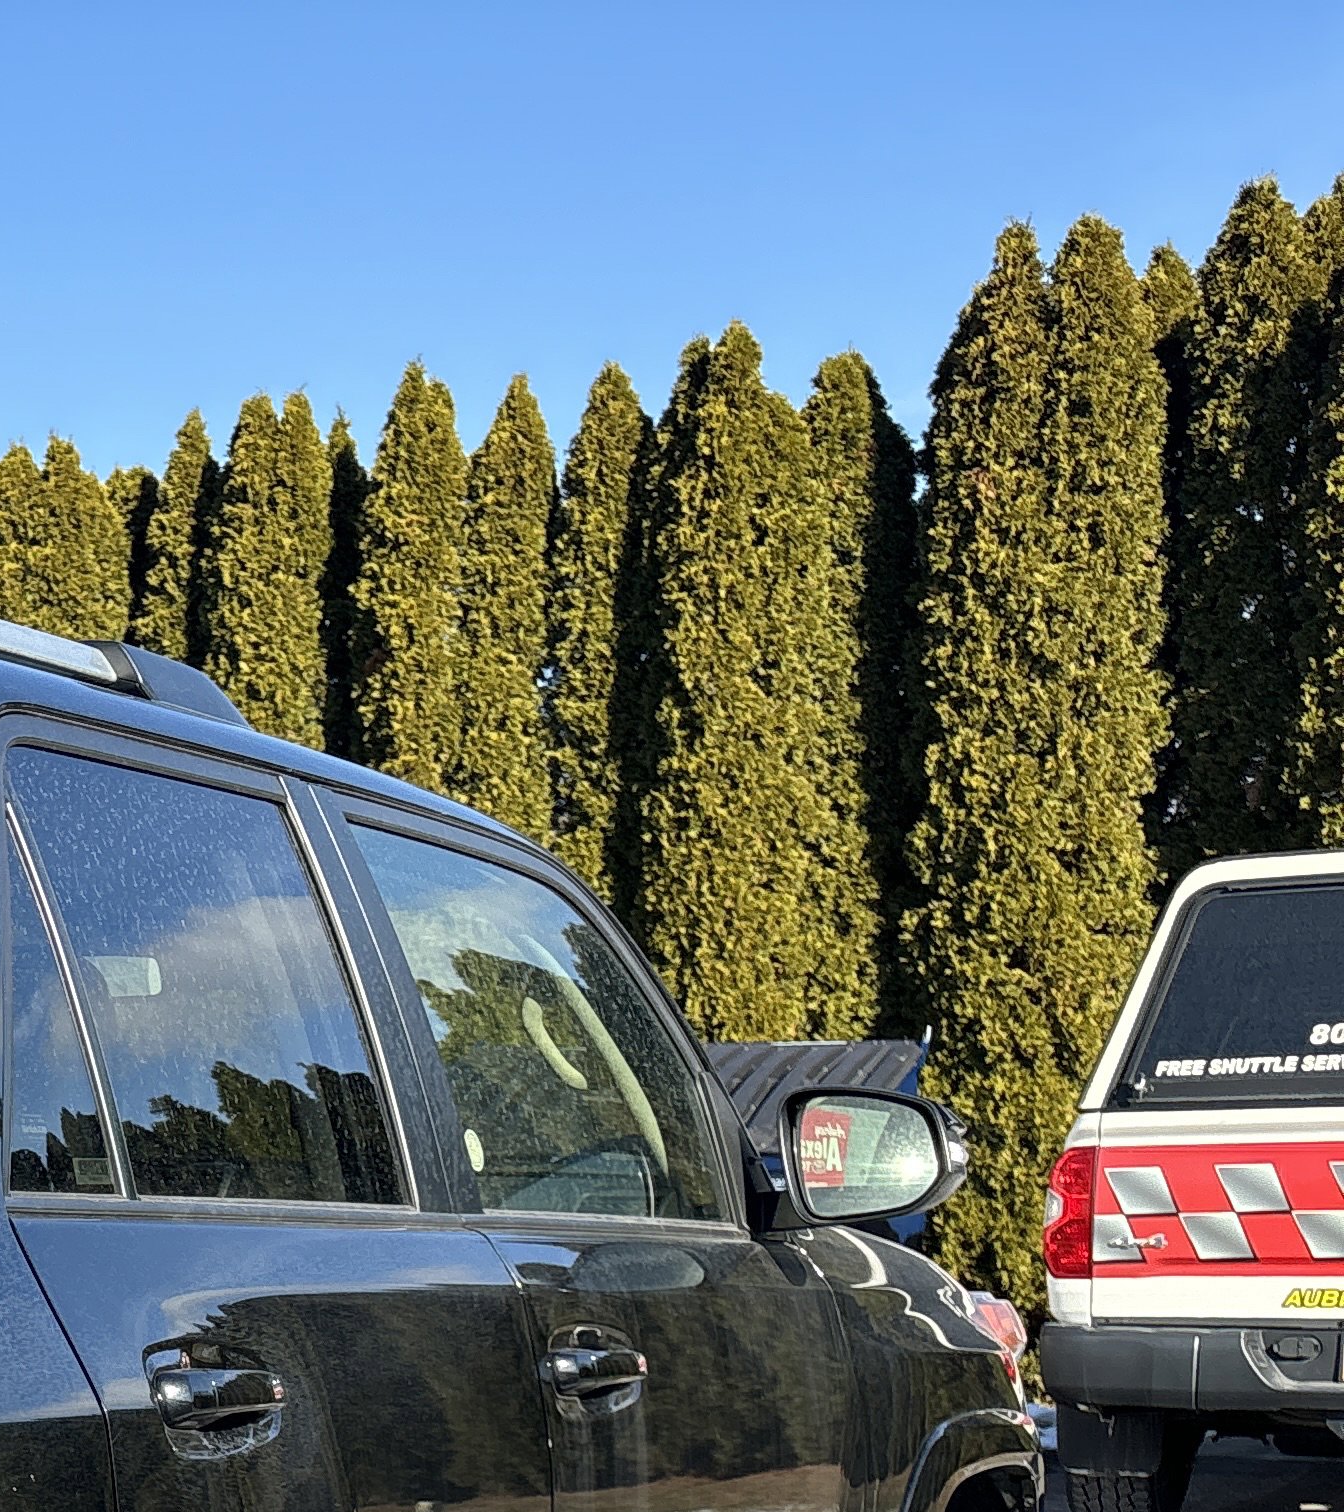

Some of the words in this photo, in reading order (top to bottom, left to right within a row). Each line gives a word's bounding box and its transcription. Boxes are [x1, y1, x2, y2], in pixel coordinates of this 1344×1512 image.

[1155, 1059, 1207, 1078] FREE
[1208, 1055, 1299, 1076] SHUTTLE
[1301, 1053, 1344, 1072] SER
[1282, 1288, 1344, 1308] AUB
